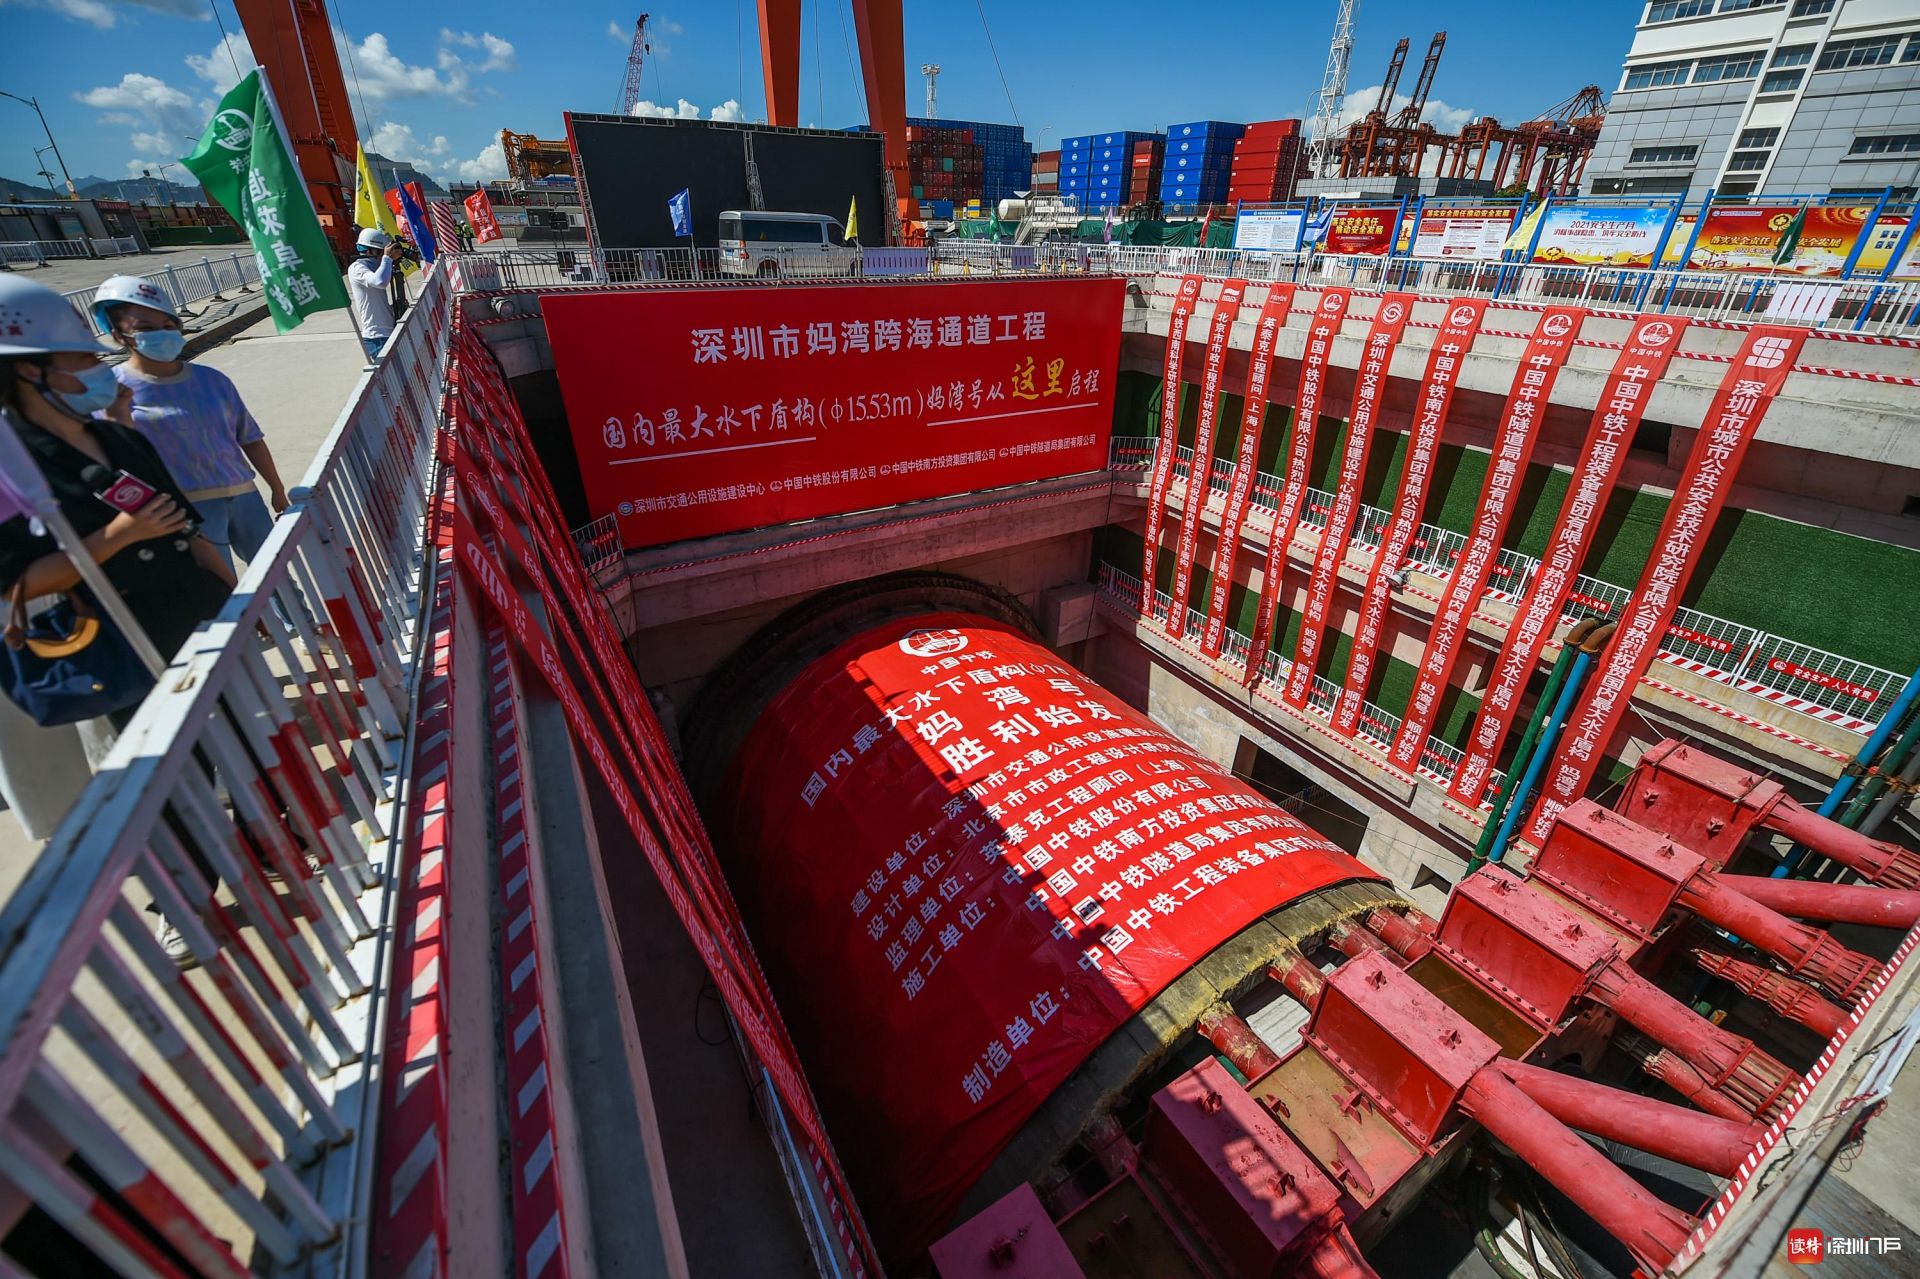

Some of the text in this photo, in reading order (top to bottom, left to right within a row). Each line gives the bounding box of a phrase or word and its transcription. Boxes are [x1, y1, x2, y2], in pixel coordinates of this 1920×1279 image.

[1570, 220, 1636, 230] 2021安全生产月
[1710, 235, 1771, 246] 落实安全责任
[691, 310, 1047, 365] 深圳市妈湾跨海通道工程
[1535, 338, 1564, 347] 中国中铁
[1629, 347, 1663, 358] 中国中铁
[634, 433, 1096, 515] 深圳市交通公用设施建设中心 中国中铁股份有限公司 中国中铁南方投资集团有限公司 中国中铁隧道局集团有限公司
[1695, 634, 1727, 651] 人人有责
[920, 649, 998, 677] 中国中铁
[1793, 667, 1873, 700] 安全生产 人人有责
[939, 699, 1123, 776] 胜利始发
